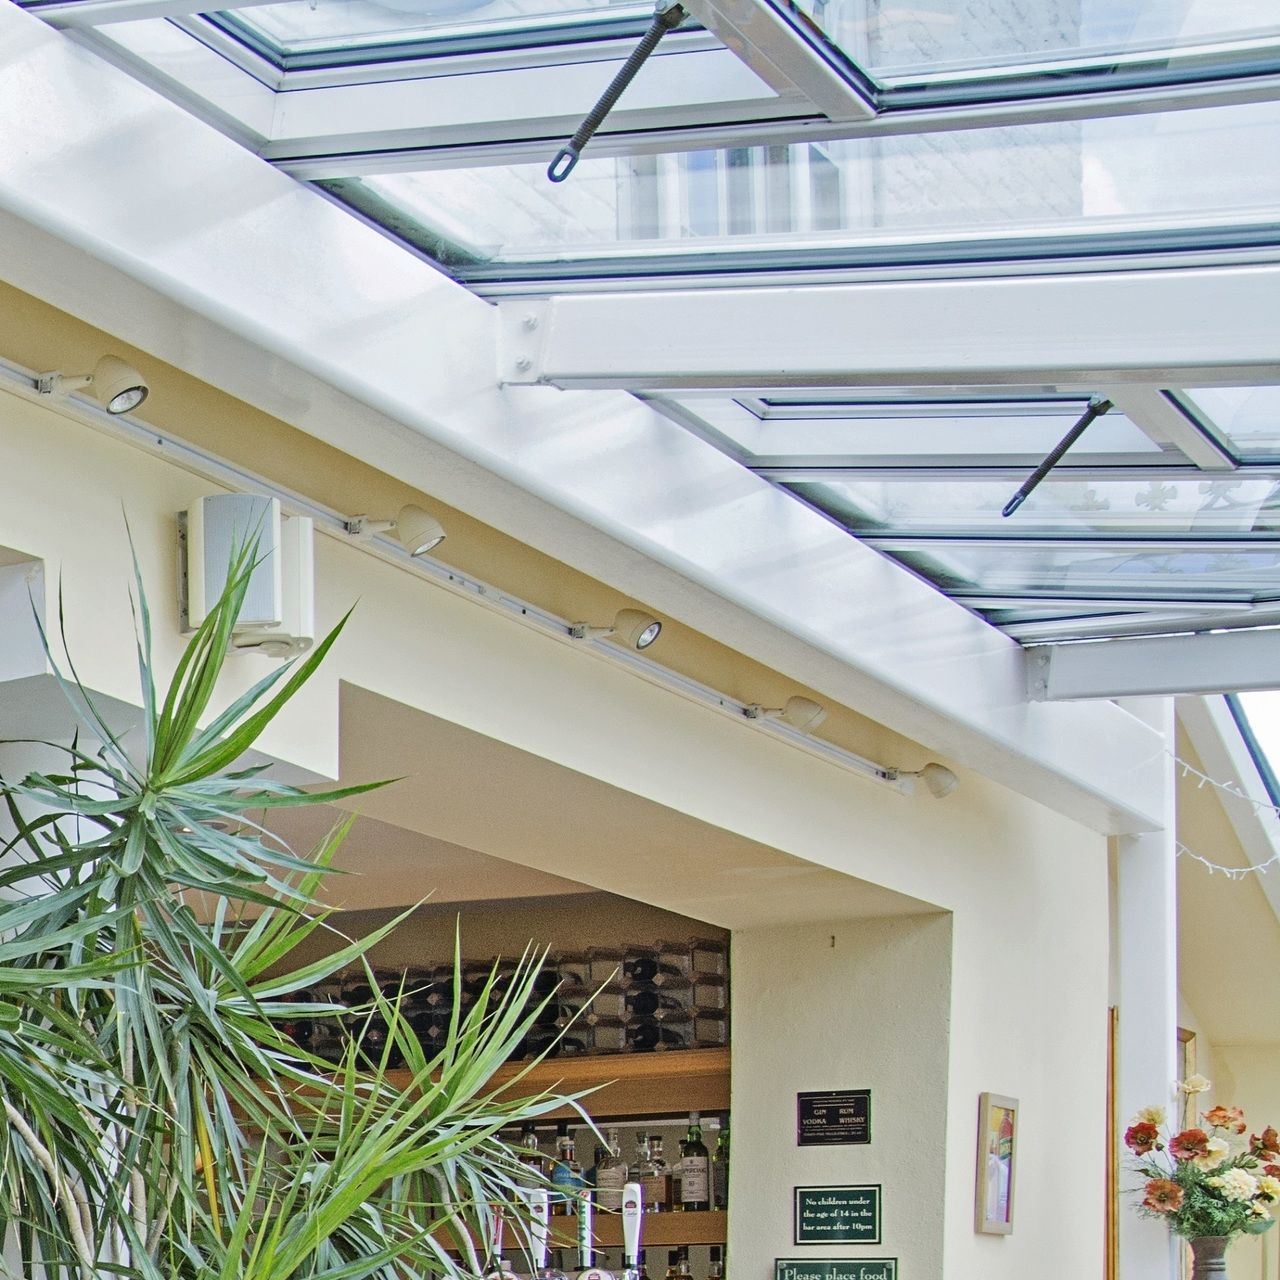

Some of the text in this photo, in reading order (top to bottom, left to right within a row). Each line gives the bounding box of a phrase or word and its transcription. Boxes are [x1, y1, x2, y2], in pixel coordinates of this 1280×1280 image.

[852, 1223, 872, 1232] 10pm
[784, 1269, 821, 1280] Please
[860, 1267, 887, 1280] food
